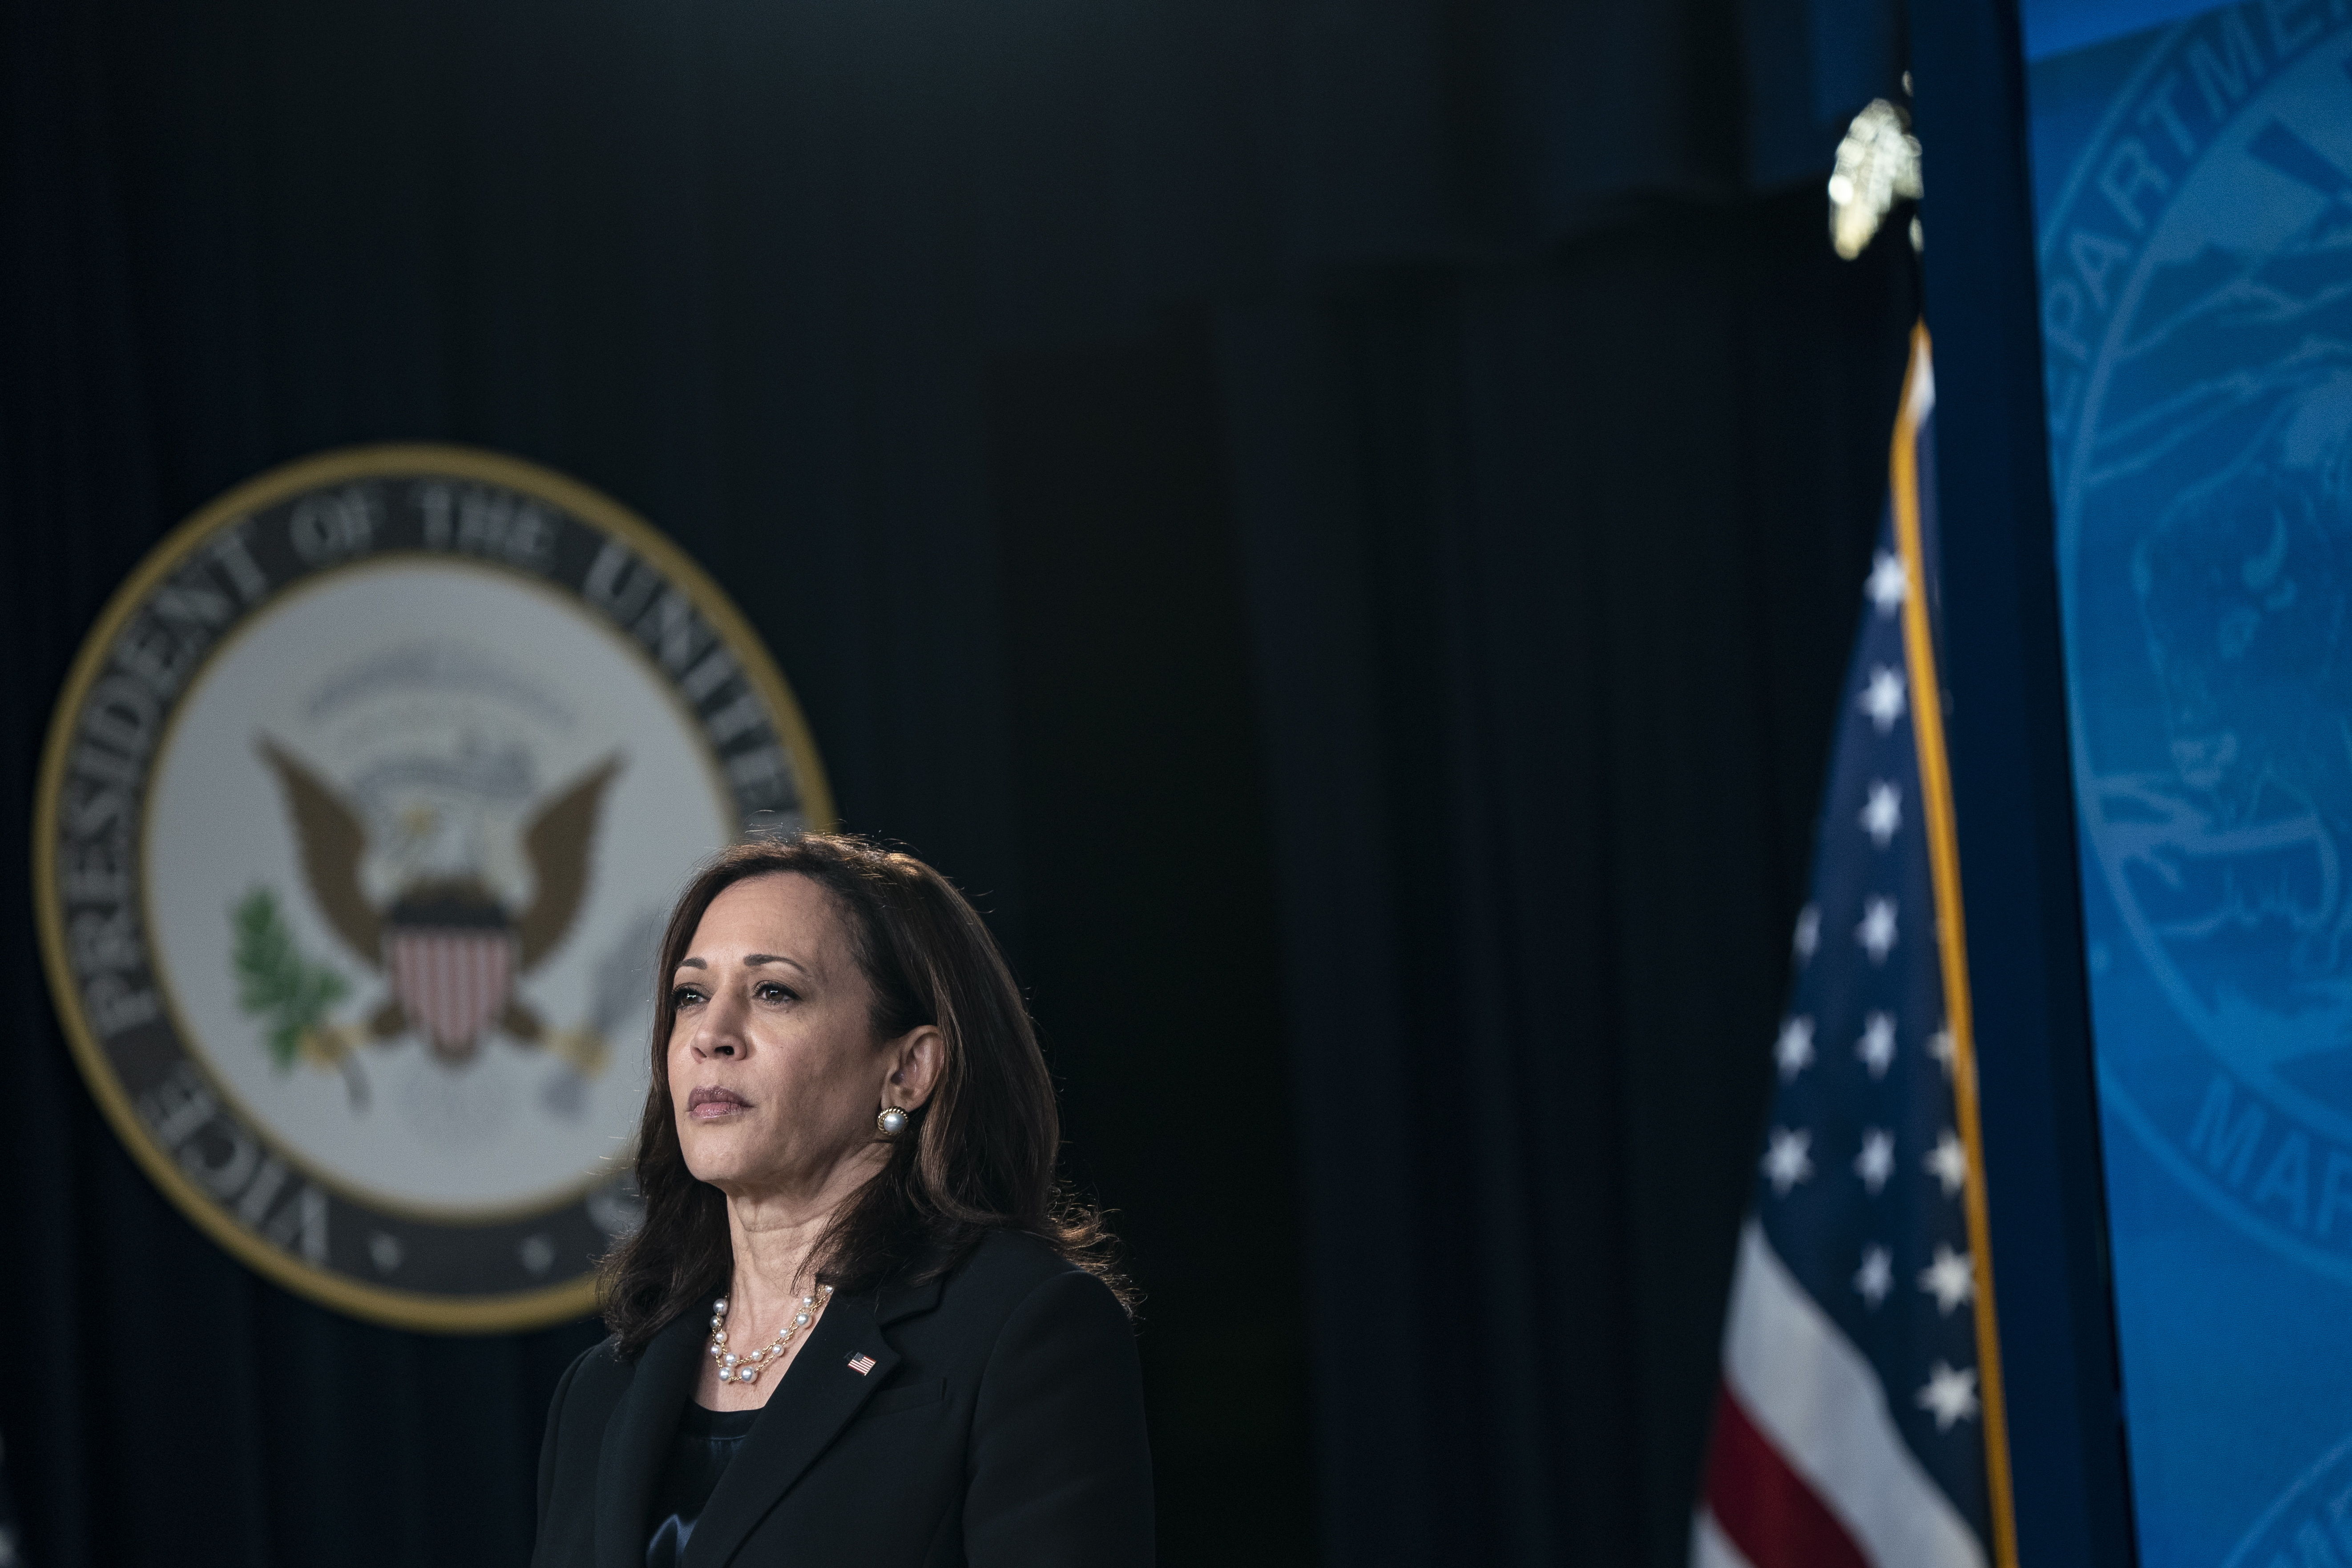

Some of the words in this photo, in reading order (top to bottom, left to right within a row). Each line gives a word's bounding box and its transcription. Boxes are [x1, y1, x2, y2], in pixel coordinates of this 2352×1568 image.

[289, 485, 386, 563] OF
[411, 485, 556, 564] THE
[60, 518, 266, 1036] PRESIDENT
[139, 1071, 329, 1266] VICE
